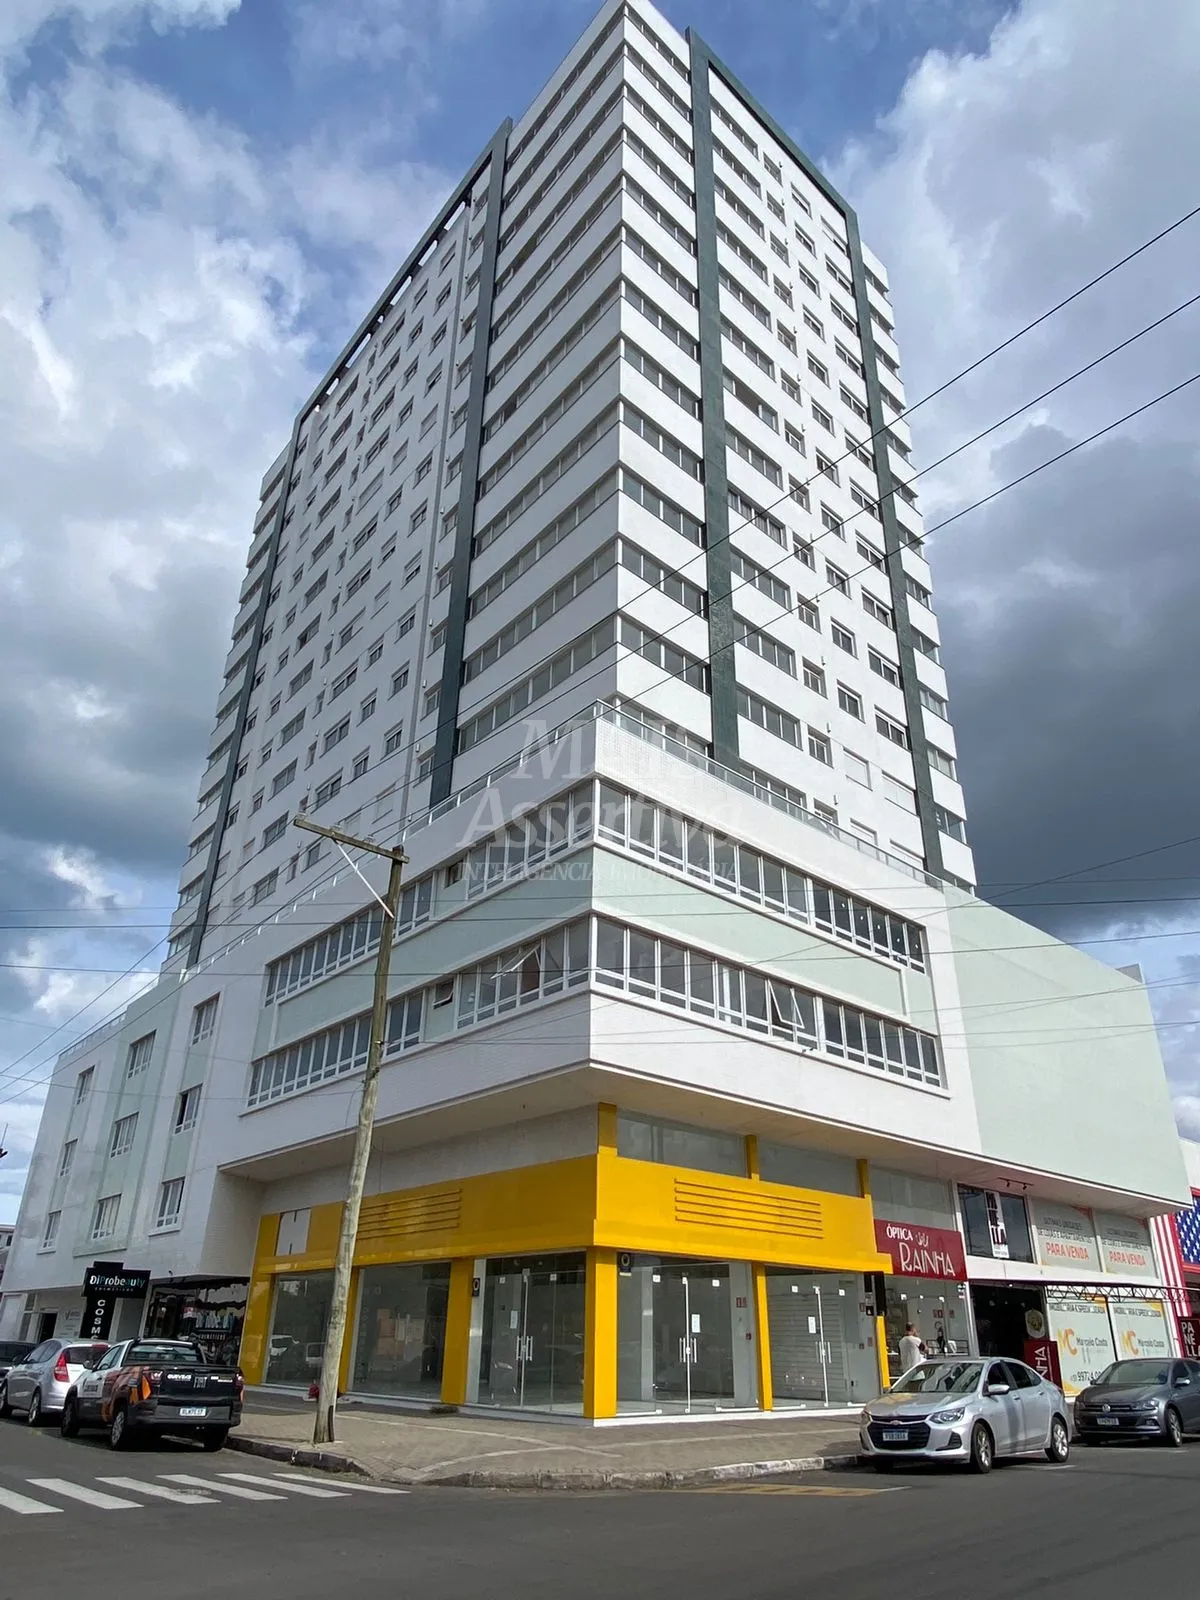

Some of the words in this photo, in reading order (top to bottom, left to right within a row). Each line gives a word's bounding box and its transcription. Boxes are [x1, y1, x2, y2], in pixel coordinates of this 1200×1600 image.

[886, 1223, 914, 1241] ÓPTICA
[899, 1241, 956, 1277] RAINHA
[1046, 1242, 1065, 1257] PARA
[1066, 1245, 1089, 1260] VENDA
